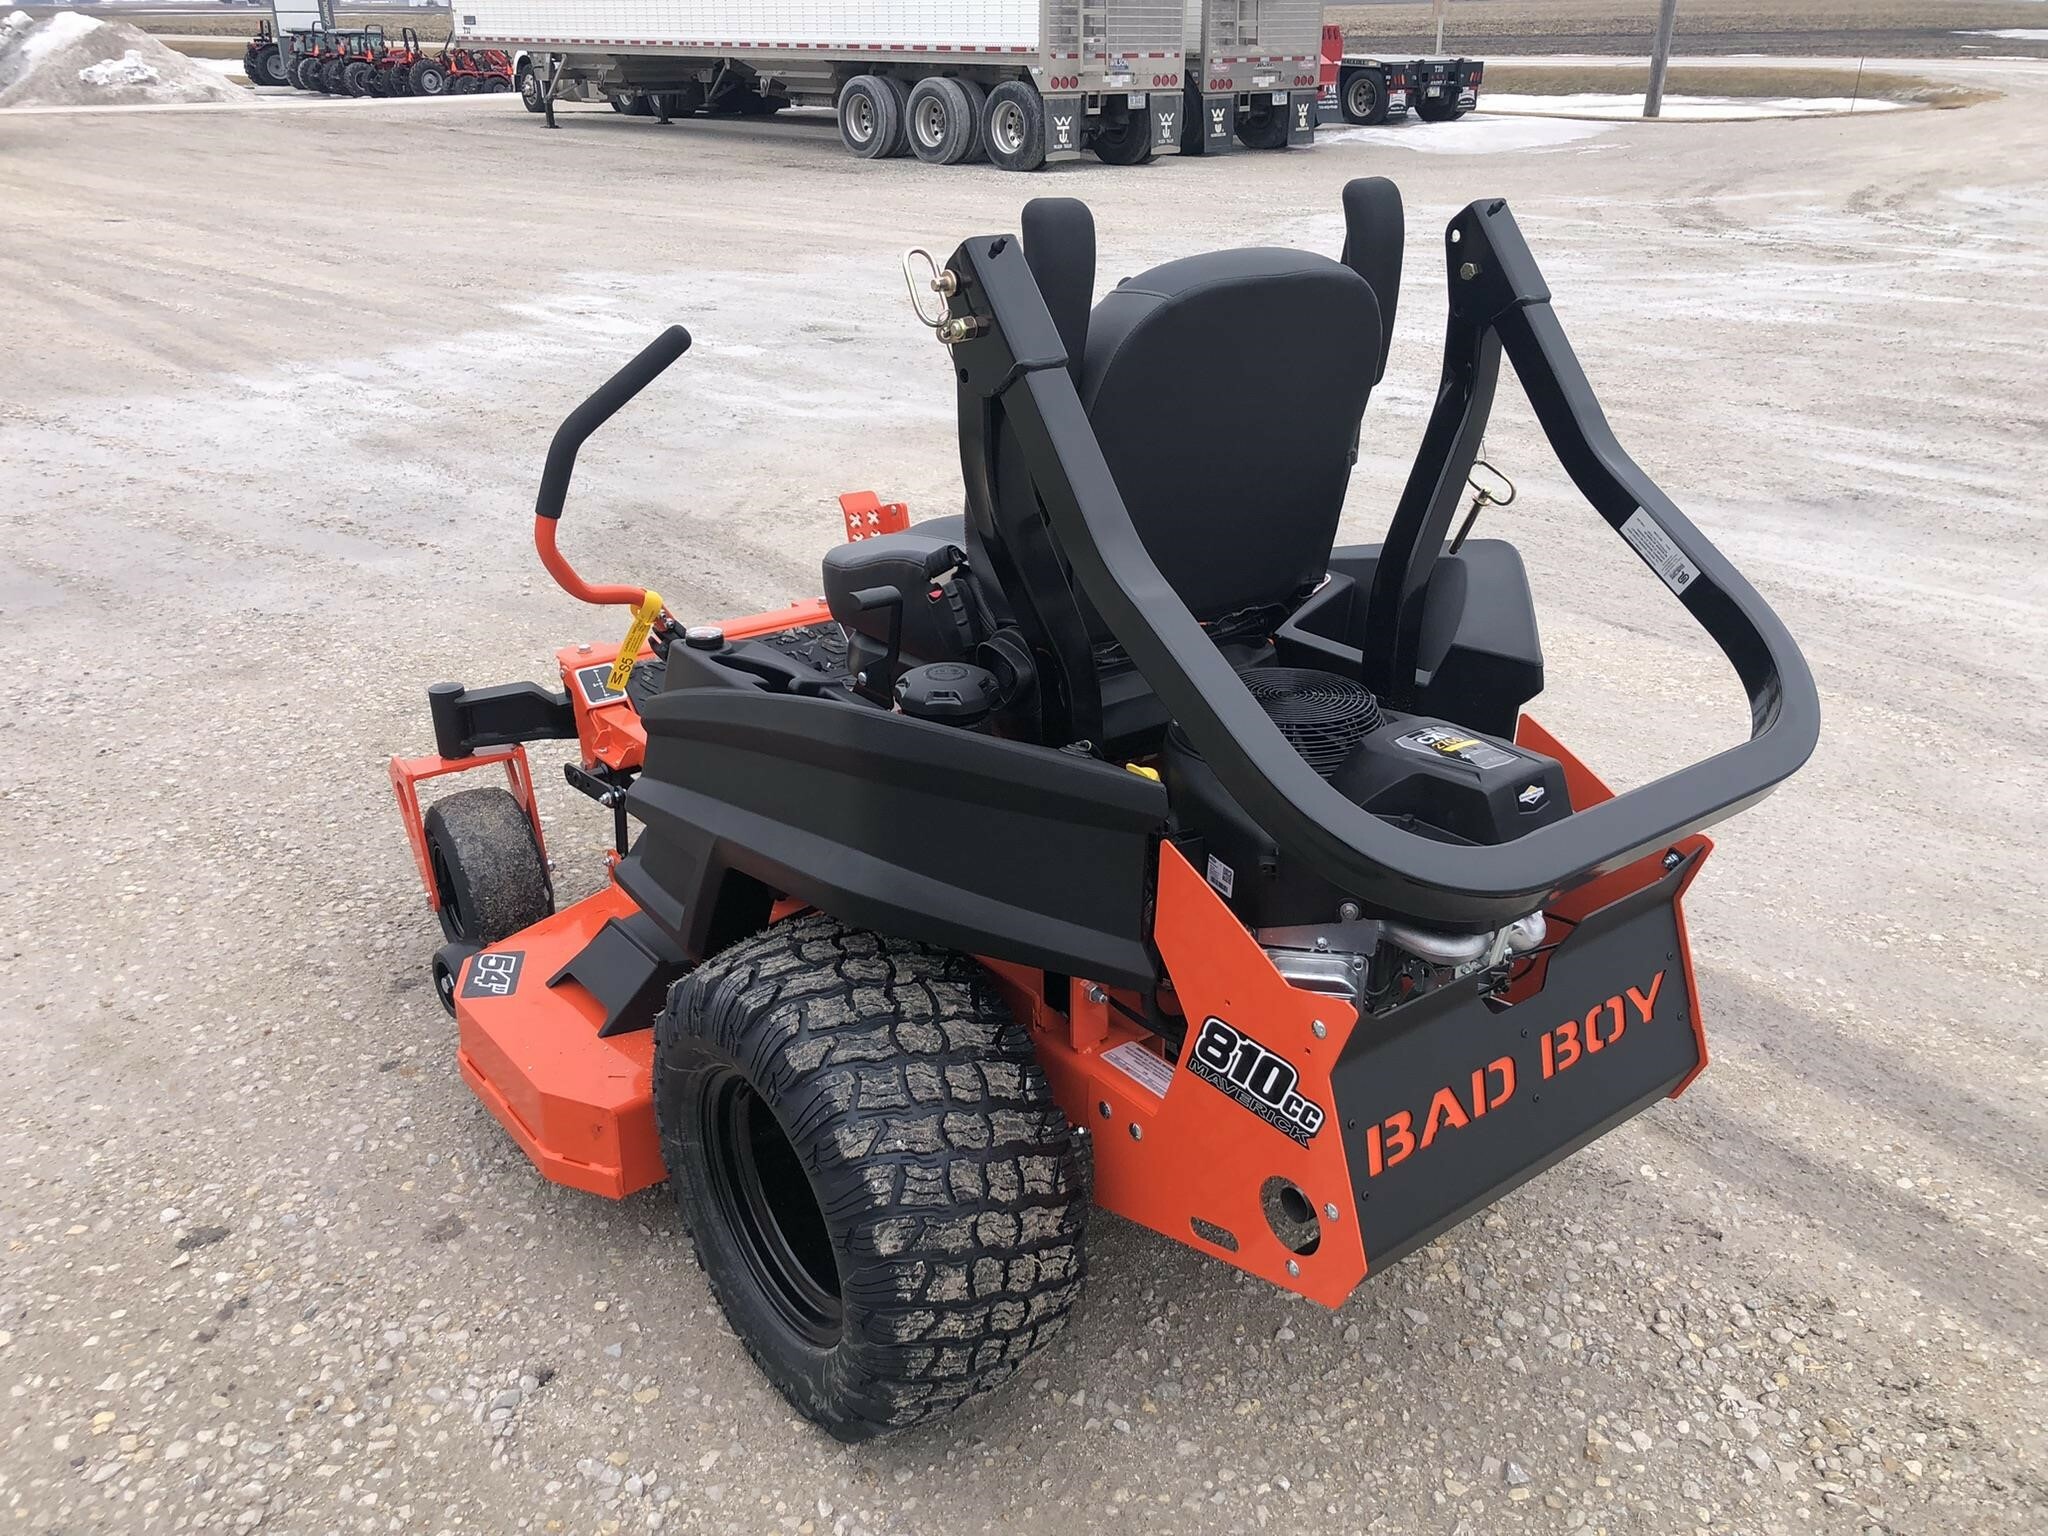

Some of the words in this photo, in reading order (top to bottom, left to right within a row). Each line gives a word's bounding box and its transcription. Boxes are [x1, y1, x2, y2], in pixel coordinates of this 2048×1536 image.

[610, 671, 623, 685] M
[619, 657, 633, 673] S5
[1366, 1055, 1517, 1177] BAD
[1540, 969, 1666, 1080] BOY
[1188, 1057, 1311, 1147] MAVERICK
